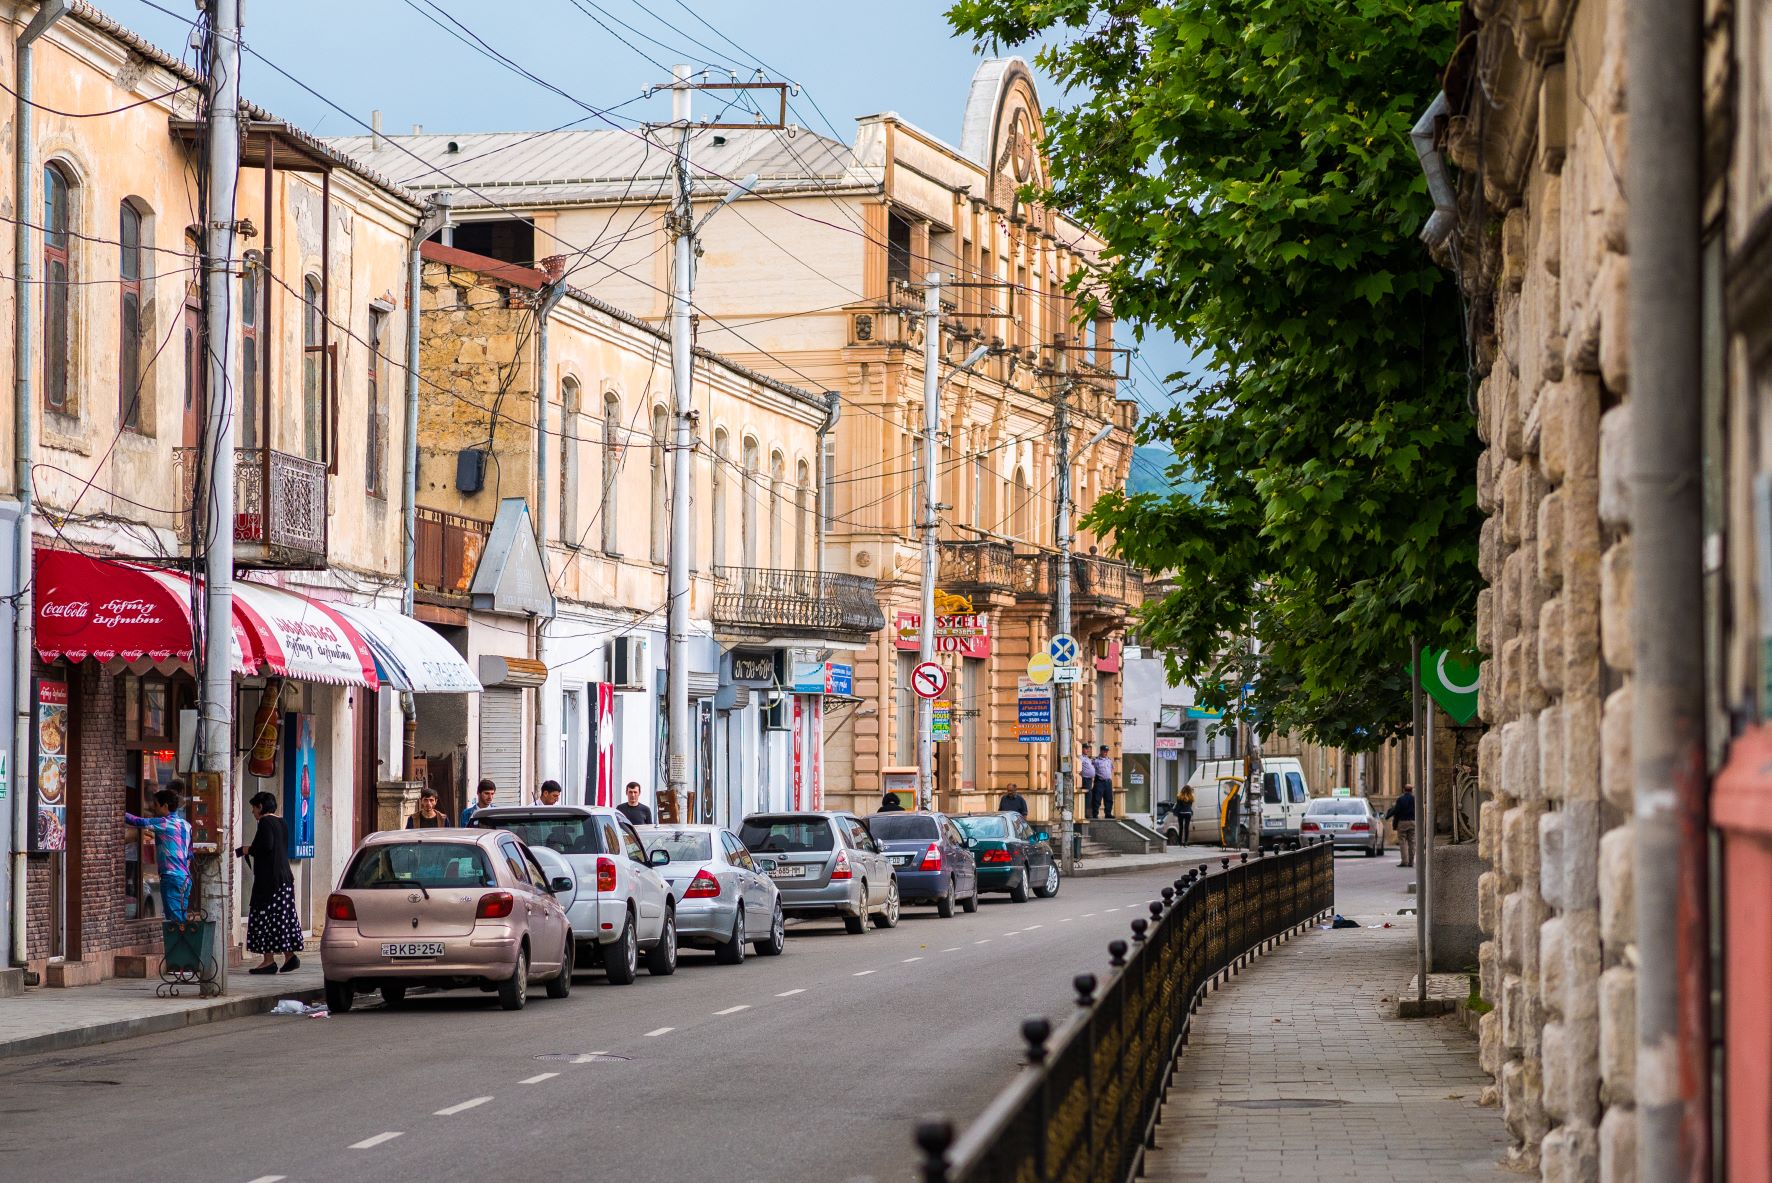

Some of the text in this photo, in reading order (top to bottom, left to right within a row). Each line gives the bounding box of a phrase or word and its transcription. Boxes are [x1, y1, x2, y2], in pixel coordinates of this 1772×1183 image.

[41, 601, 90, 618] Coca-Cola
[911, 615, 983, 628] HSTEL
[935, 636, 976, 653] ION
[390, 944, 442, 955] BKB-254
